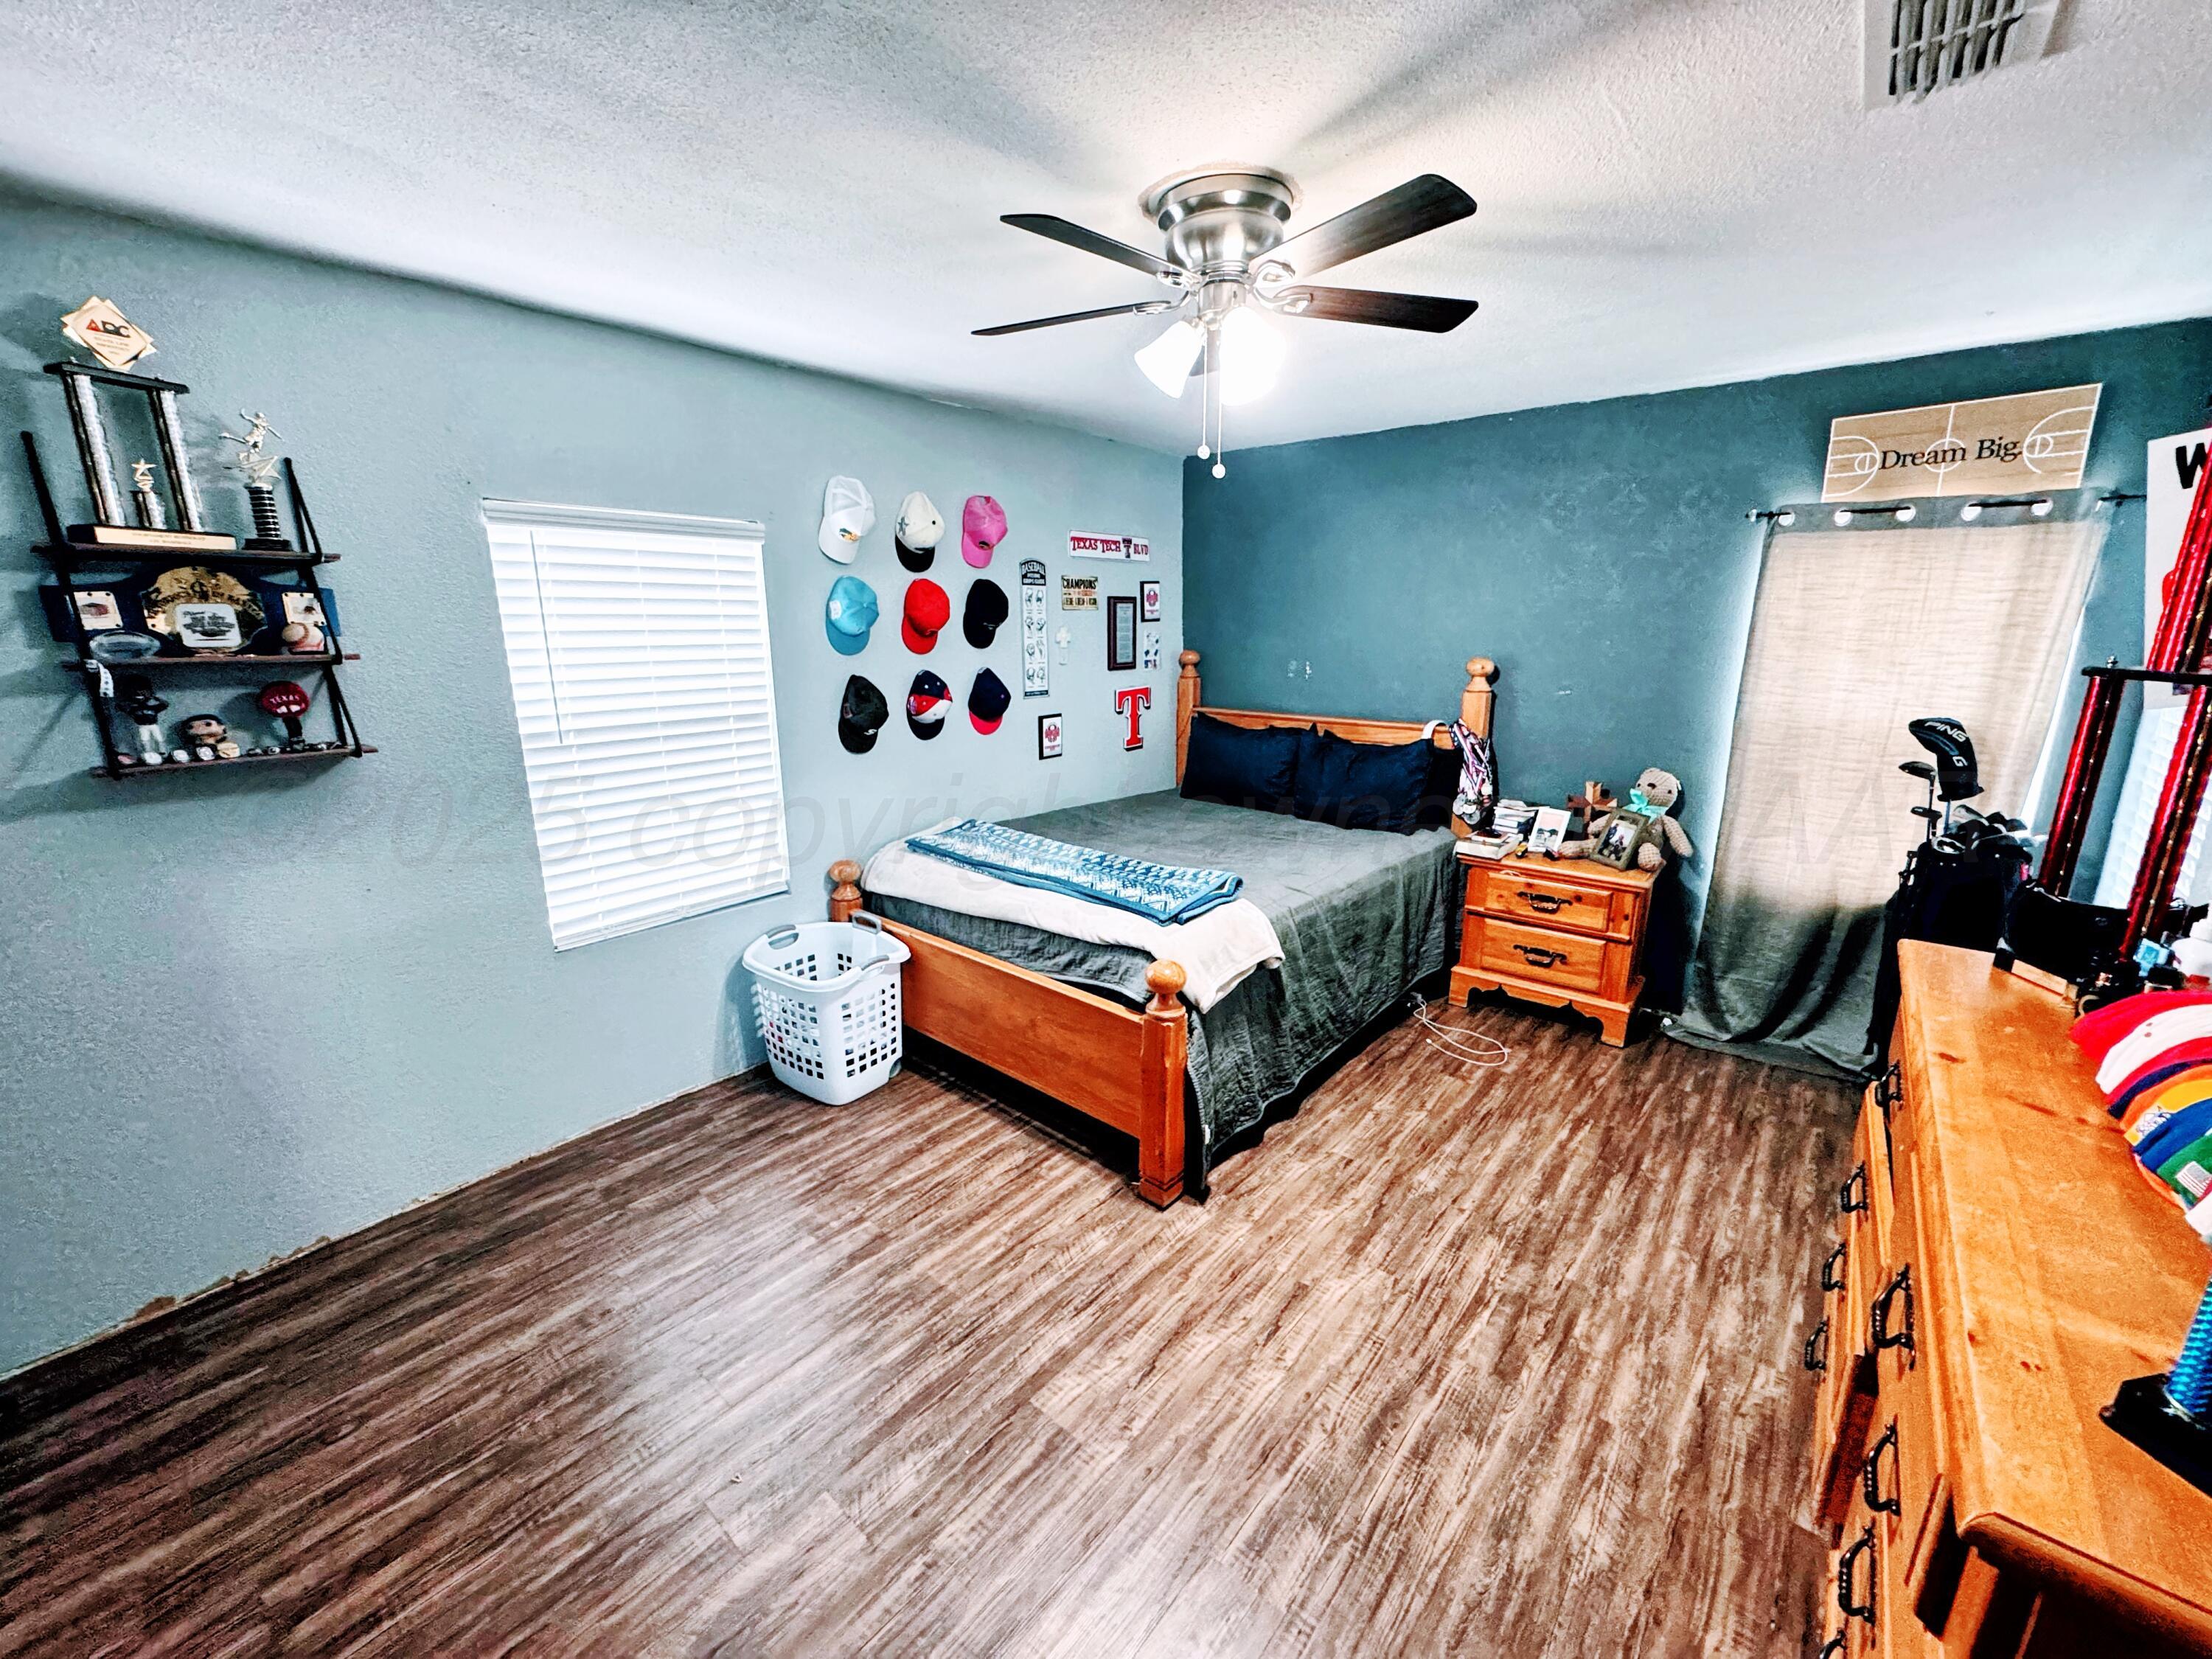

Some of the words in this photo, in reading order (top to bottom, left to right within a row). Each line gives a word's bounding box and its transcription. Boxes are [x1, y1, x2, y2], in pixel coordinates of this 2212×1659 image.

[1879, 446, 1967, 470] Dream
[1071, 536, 1098, 552] TEXAS
[1100, 538, 1121, 554] TECH
[1133, 543, 1149, 556] BLVD
[1062, 578, 1096, 590] CHAMPIONS
[1924, 721, 1969, 742] PING
[1952, 756, 1968, 767] G
